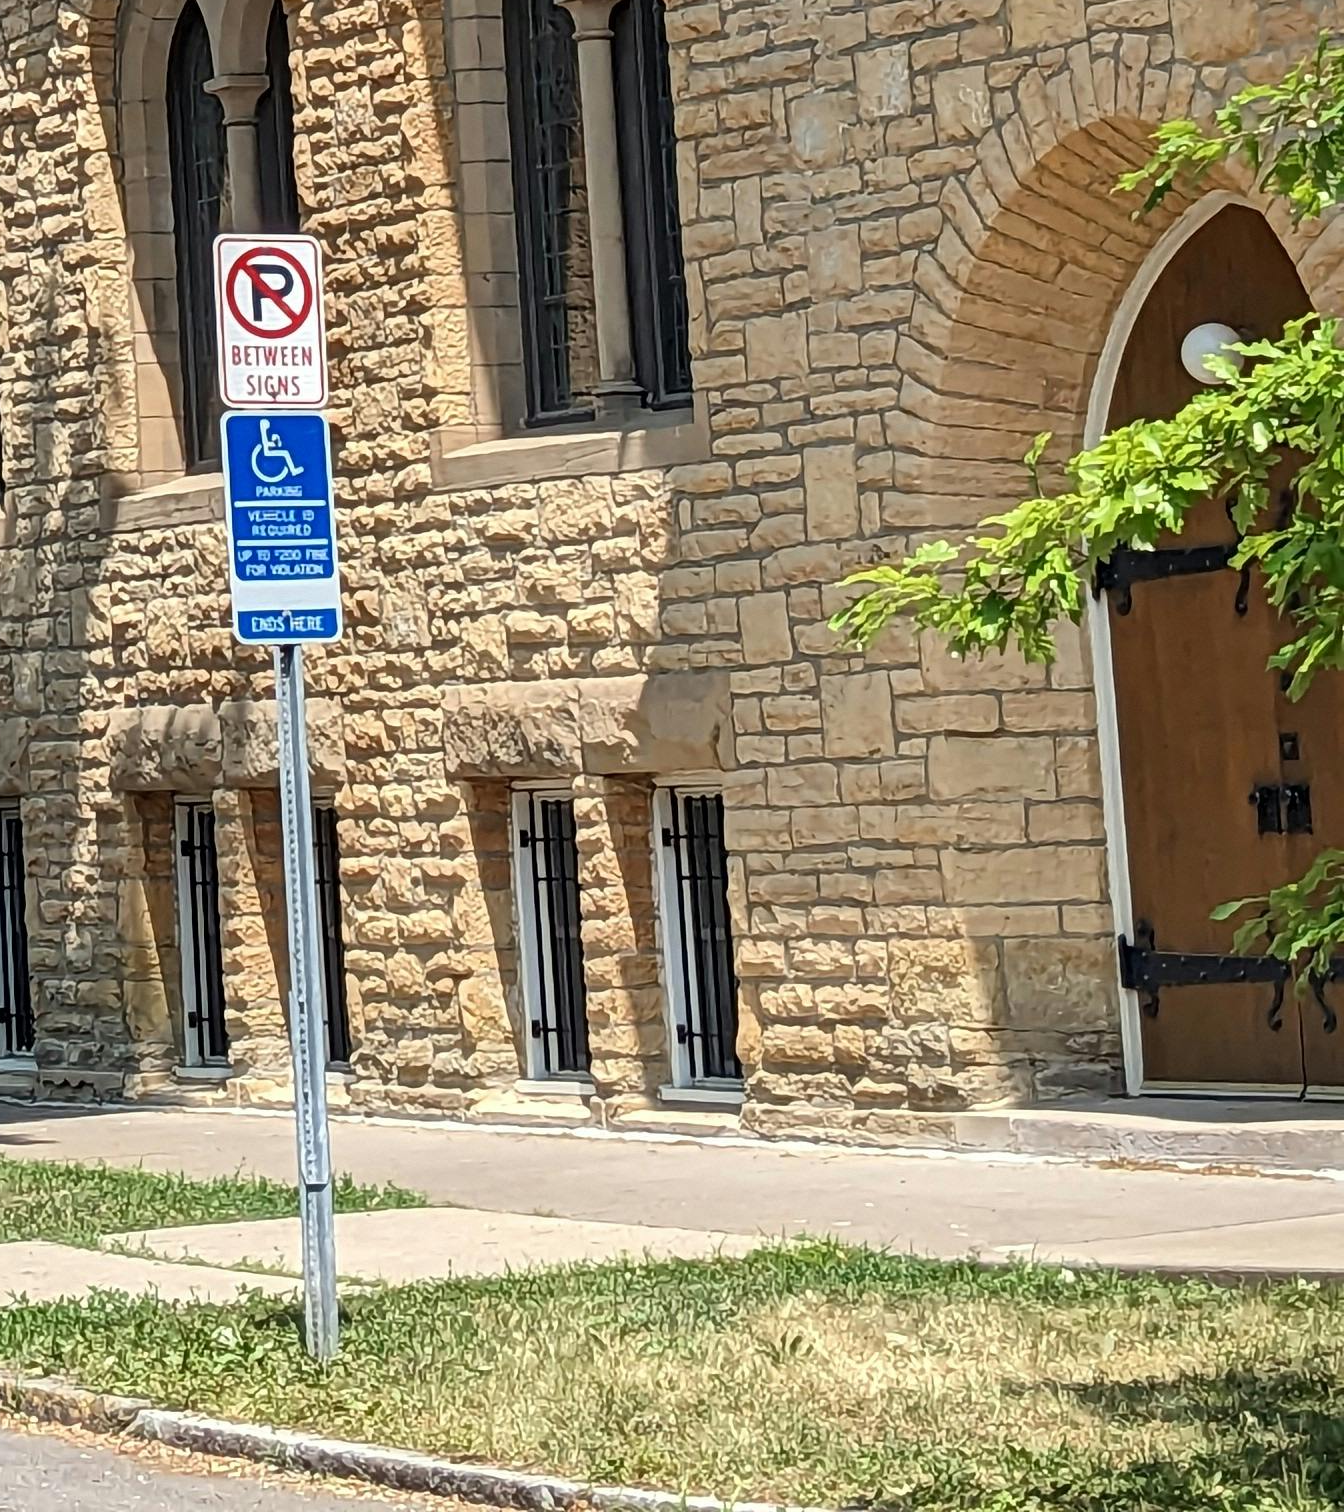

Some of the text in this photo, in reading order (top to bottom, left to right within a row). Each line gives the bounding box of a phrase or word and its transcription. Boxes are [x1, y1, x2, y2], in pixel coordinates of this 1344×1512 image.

[231, 344, 313, 367] BETWEEN
[245, 374, 301, 397] SIGNS
[255, 485, 303, 498] PARKING
[247, 509, 315, 523] VEHICLE ID
[251, 523, 312, 536] REQUIRED
[237, 549, 253, 562] UP
[257, 549, 271, 562] TO
[305, 548, 330, 561] FINE
[245, 563, 324, 577] FOR VIOLATION
[251, 615, 325, 633] ENDS HERE
